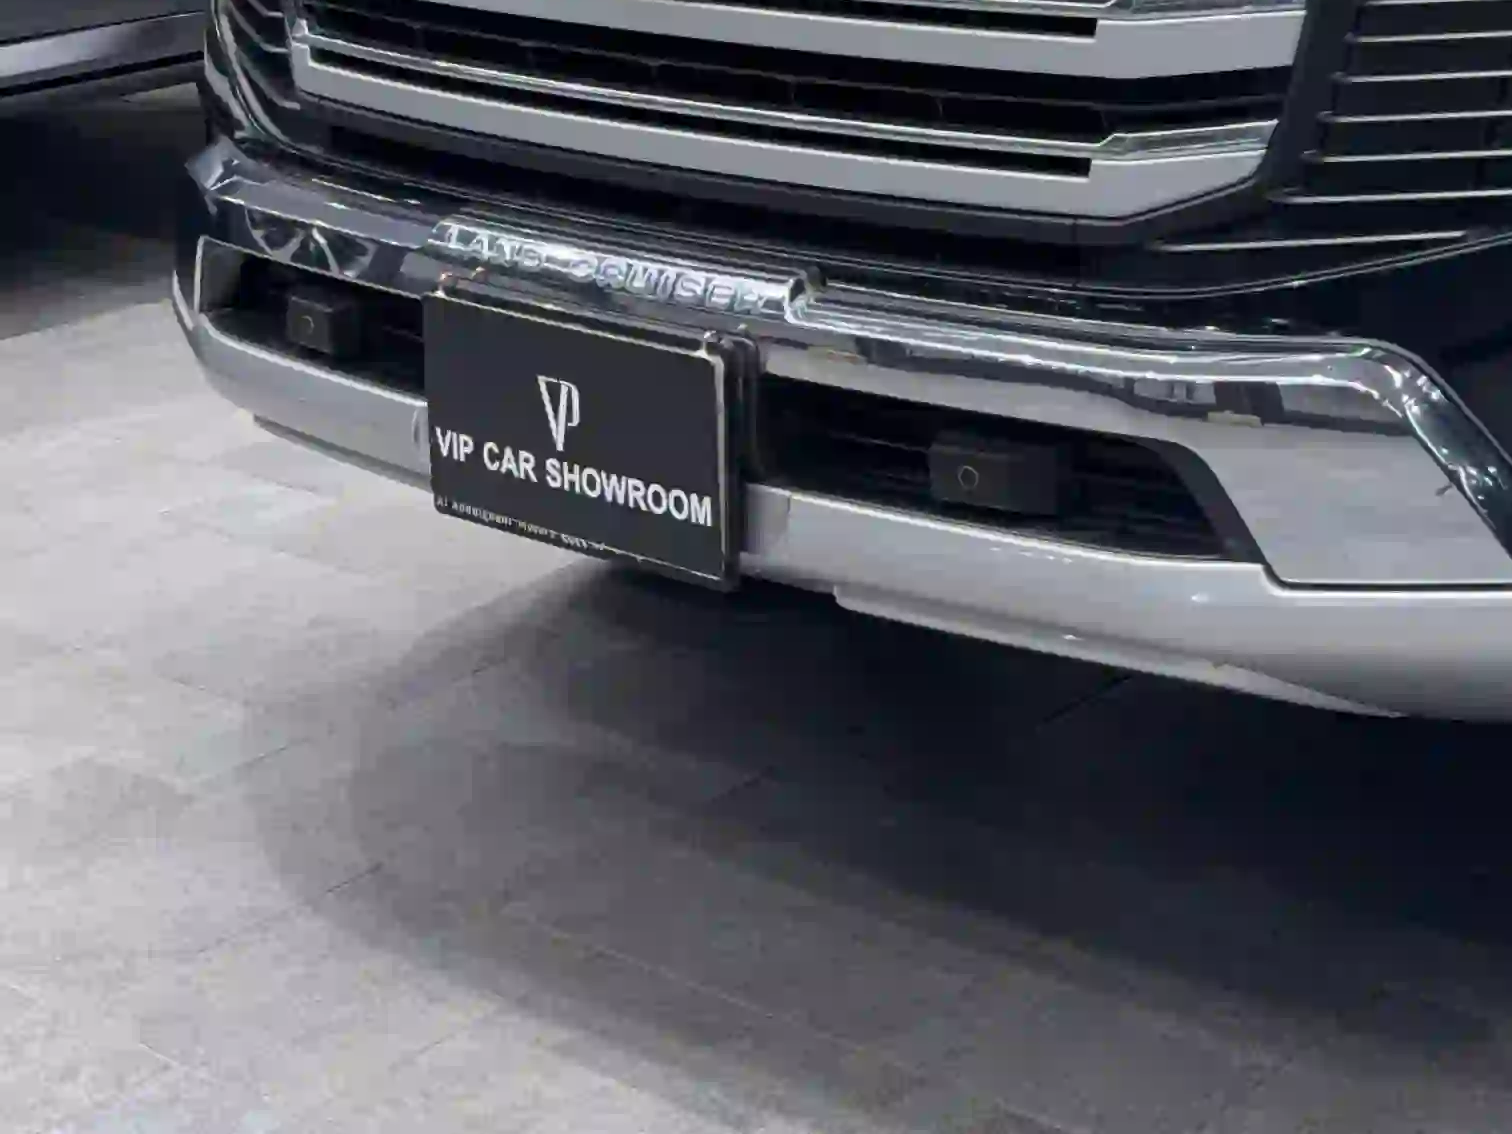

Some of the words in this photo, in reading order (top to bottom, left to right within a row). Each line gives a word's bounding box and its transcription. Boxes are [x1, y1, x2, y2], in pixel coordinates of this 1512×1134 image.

[566, 252, 766, 315] CRUISER
[435, 426, 474, 463] VIP
[483, 441, 538, 483] CAR
[545, 457, 713, 527] SHOWROOM
